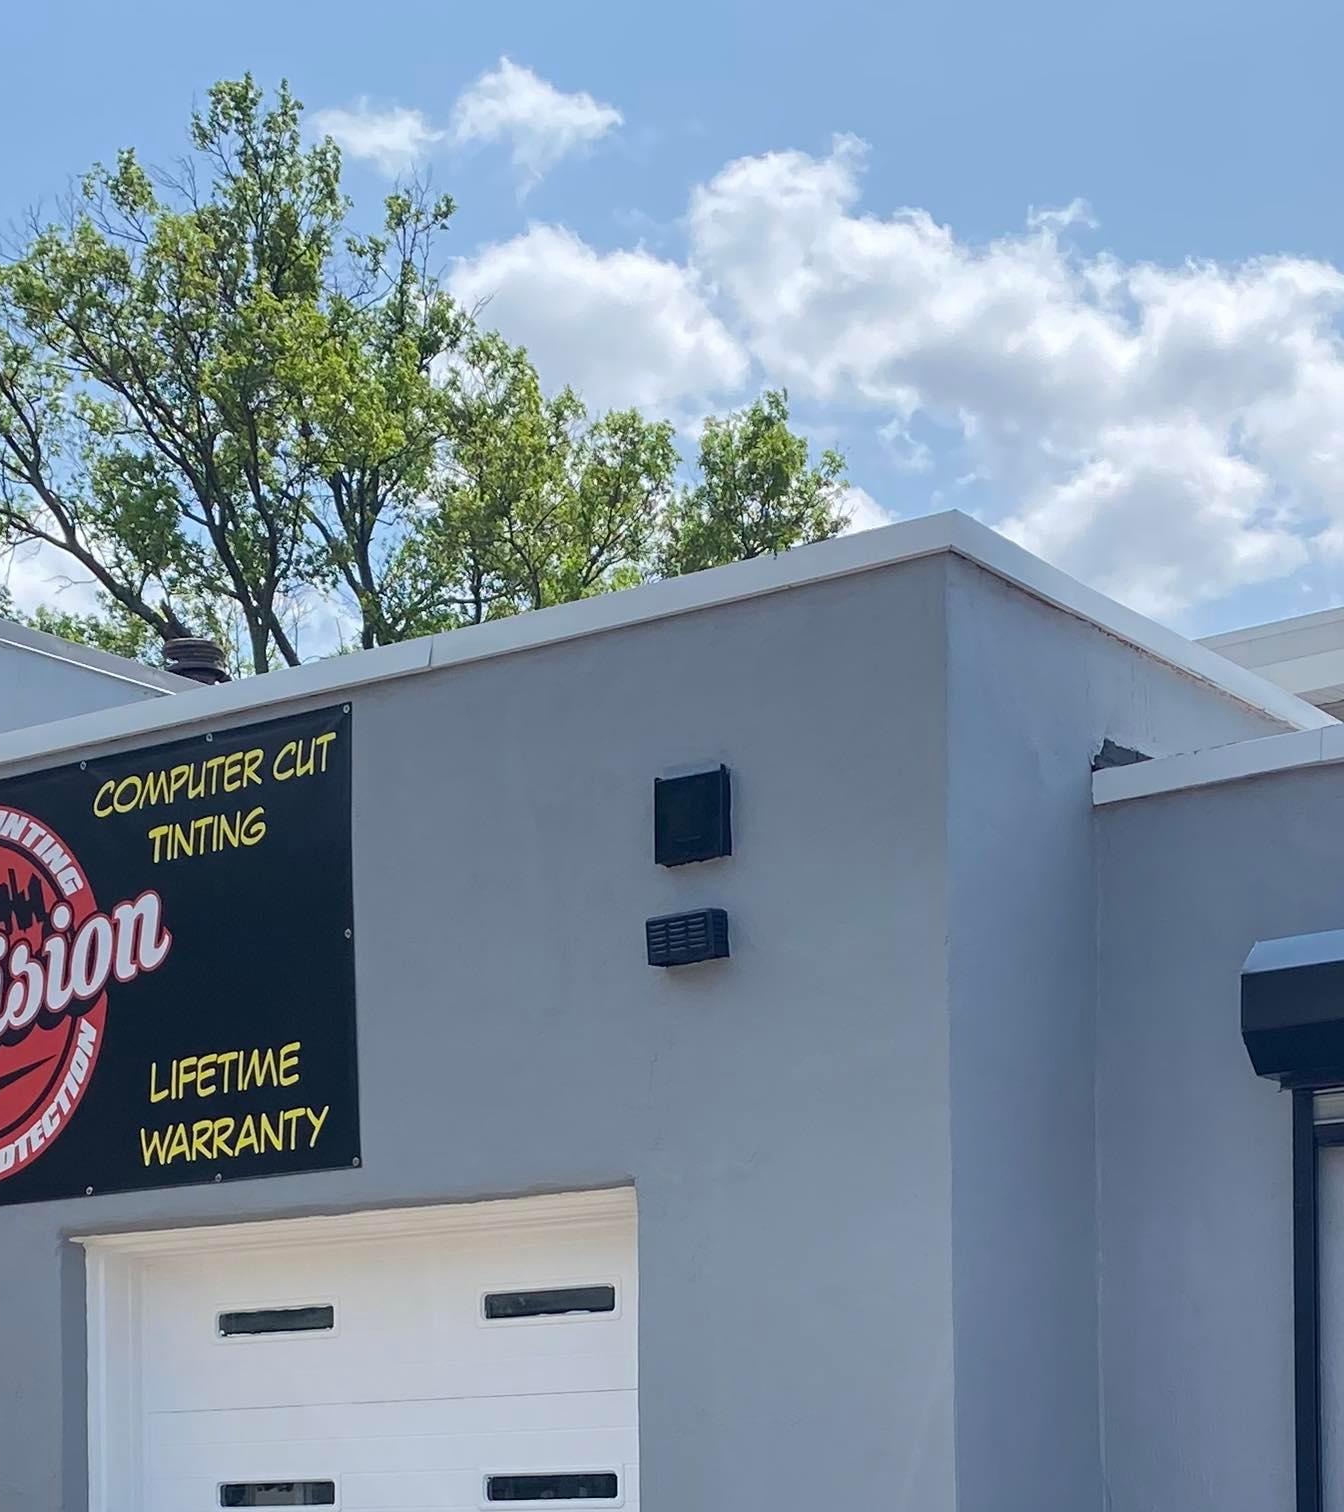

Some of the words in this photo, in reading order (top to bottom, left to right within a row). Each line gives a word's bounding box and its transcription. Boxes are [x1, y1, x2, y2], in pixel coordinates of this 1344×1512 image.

[92, 748, 265, 819] COMPUTER
[272, 731, 337, 782] CUT
[148, 806, 266, 864] TINTING
[150, 1041, 301, 1103] LIFETIME
[140, 1105, 330, 1167] WARRANTY
